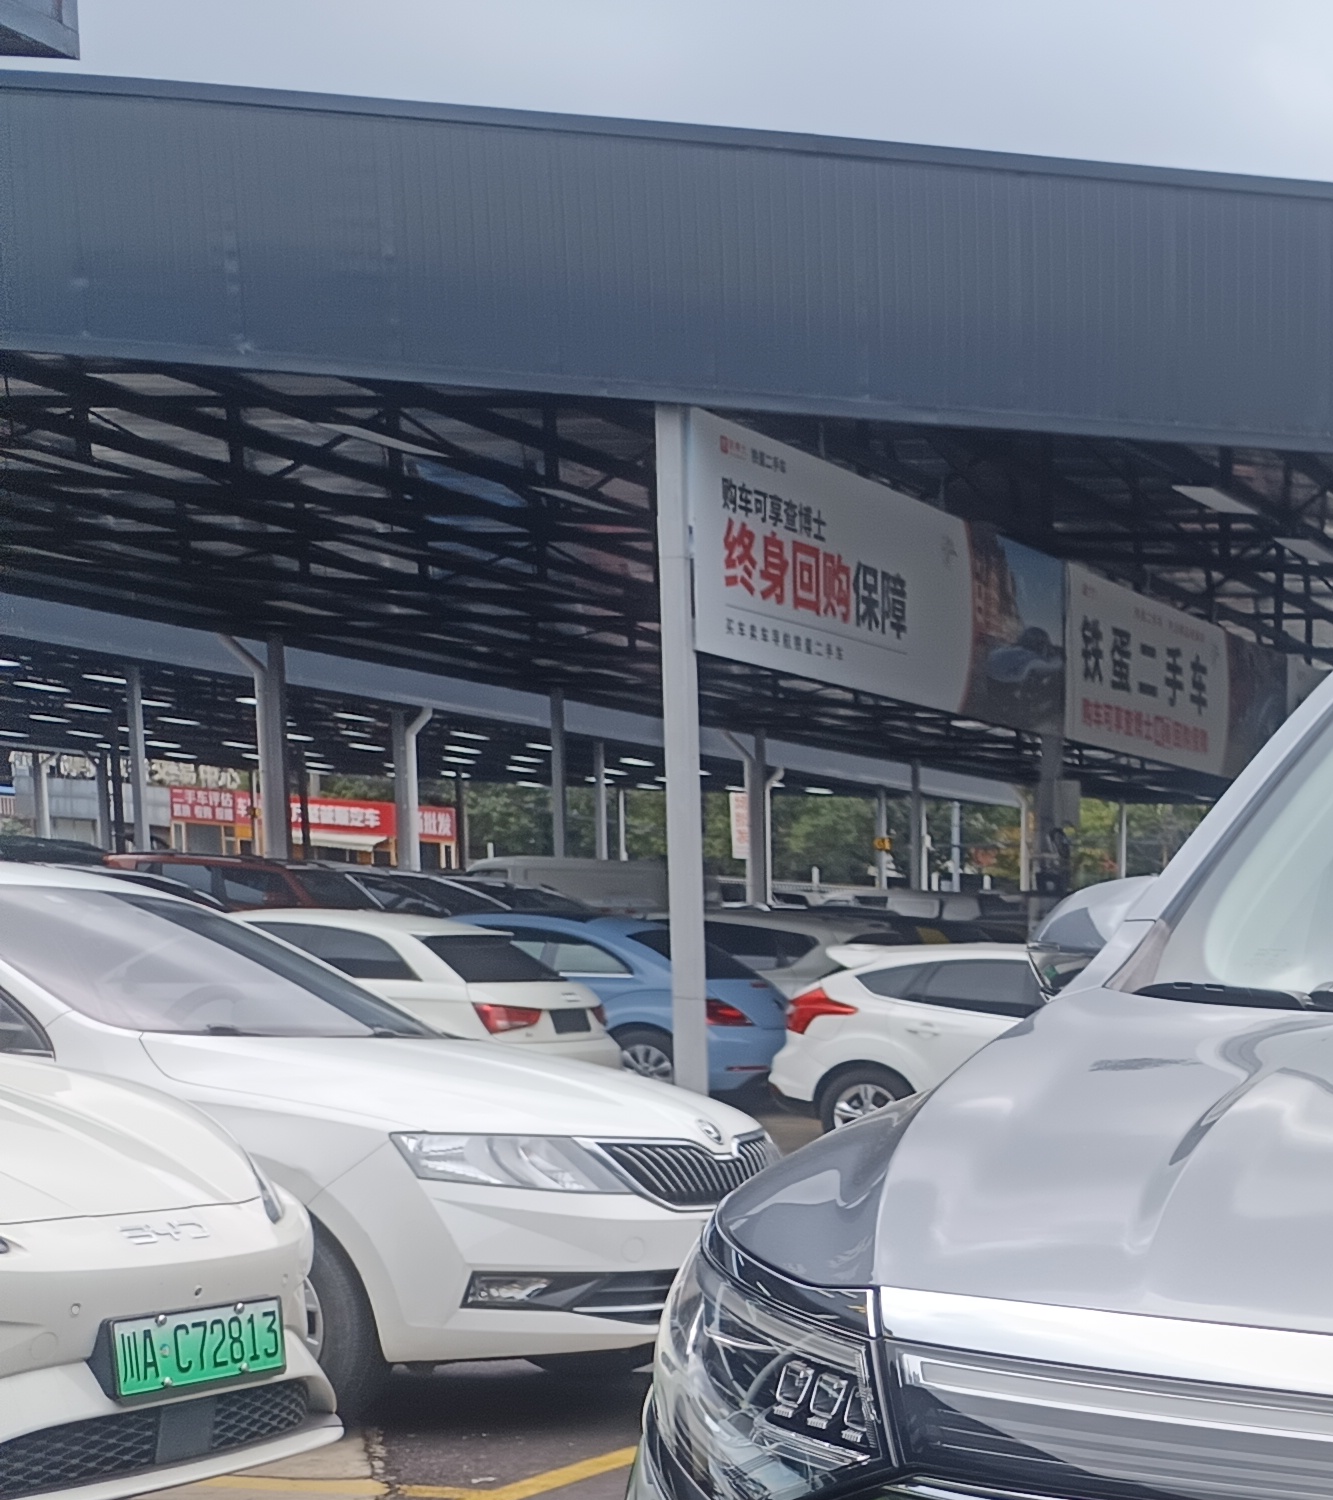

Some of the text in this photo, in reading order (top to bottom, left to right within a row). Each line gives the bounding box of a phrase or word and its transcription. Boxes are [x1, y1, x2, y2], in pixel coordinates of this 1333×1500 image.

[721, 477, 827, 542] 购车可享查博士
[723, 517, 908, 641] 终身回购保障
[1081, 614, 1208, 717] 铁蛋二手车
